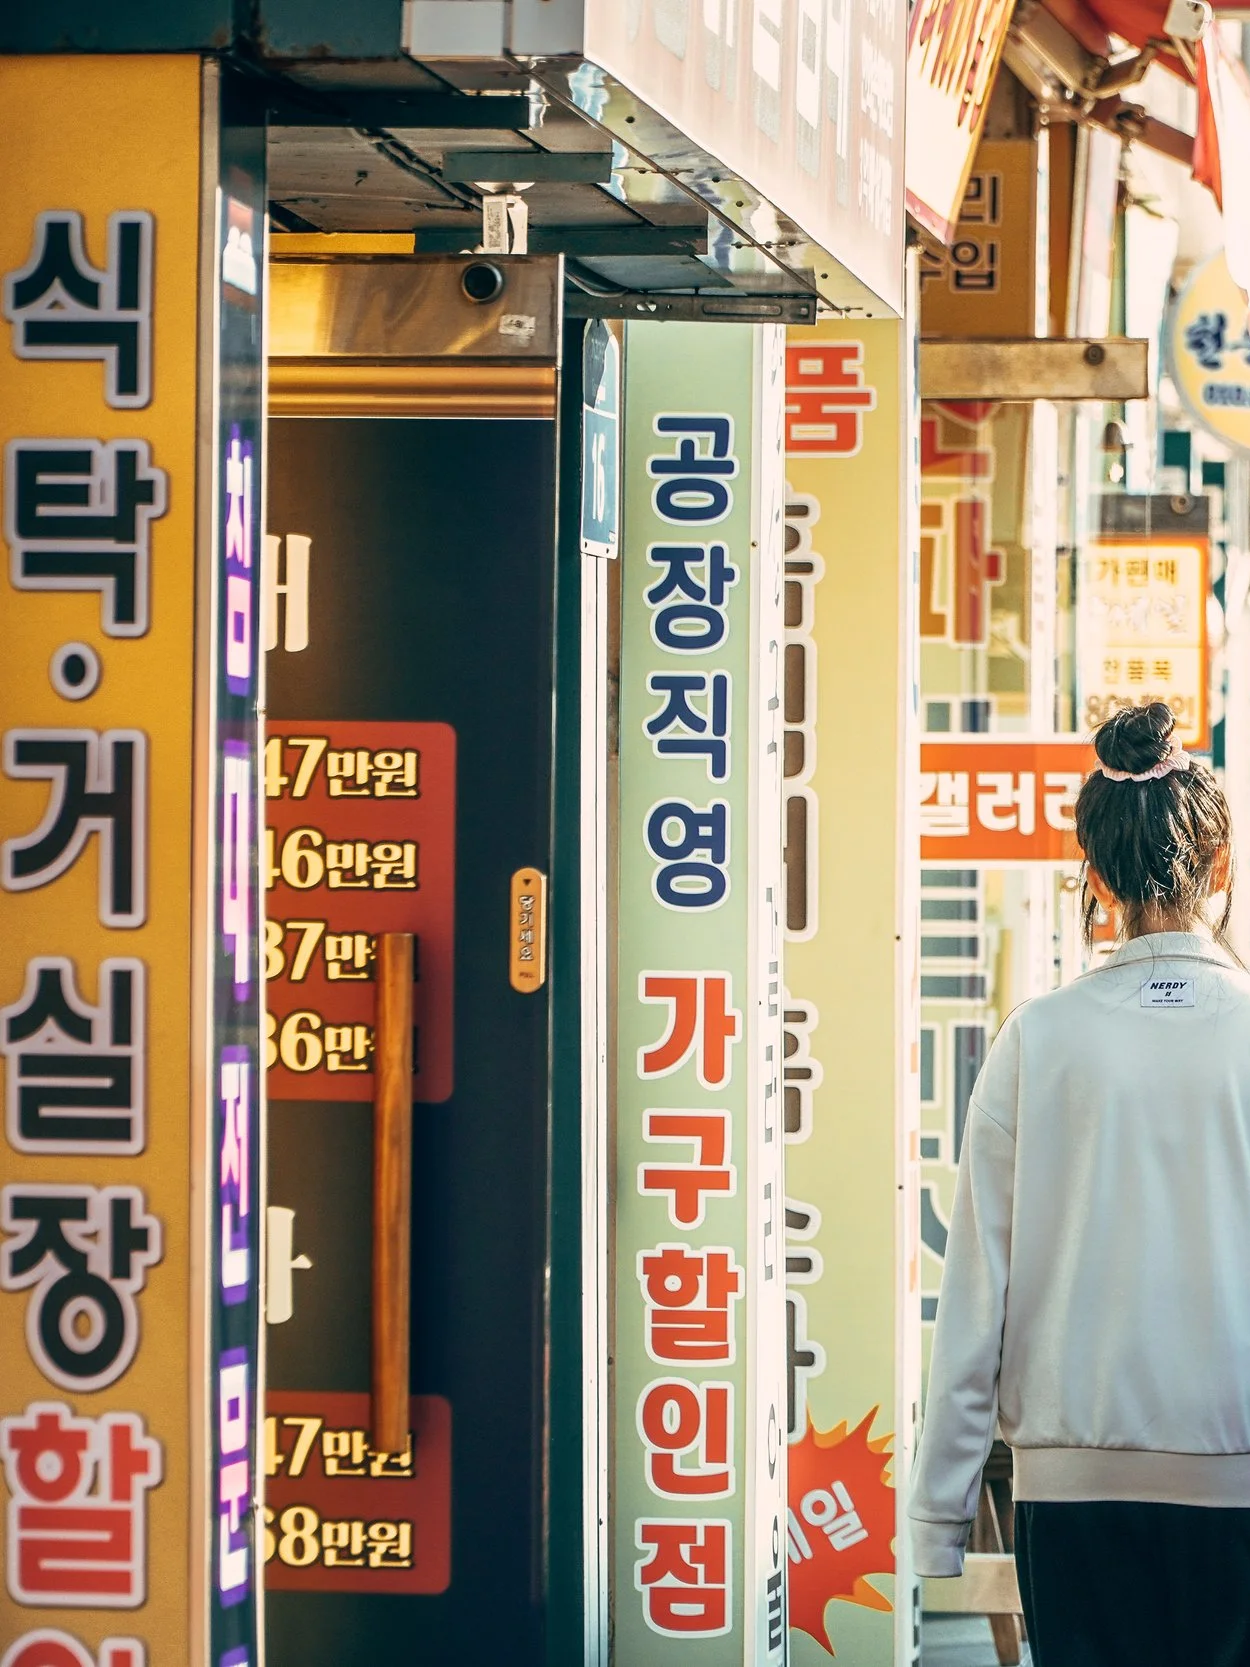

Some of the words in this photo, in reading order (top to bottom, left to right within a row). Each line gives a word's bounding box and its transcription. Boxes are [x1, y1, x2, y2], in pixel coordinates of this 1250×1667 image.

[642, 412, 740, 914] 공장직영
[1150, 981, 1187, 990] NERDY
[635, 968, 744, 1642] 가구할인점
